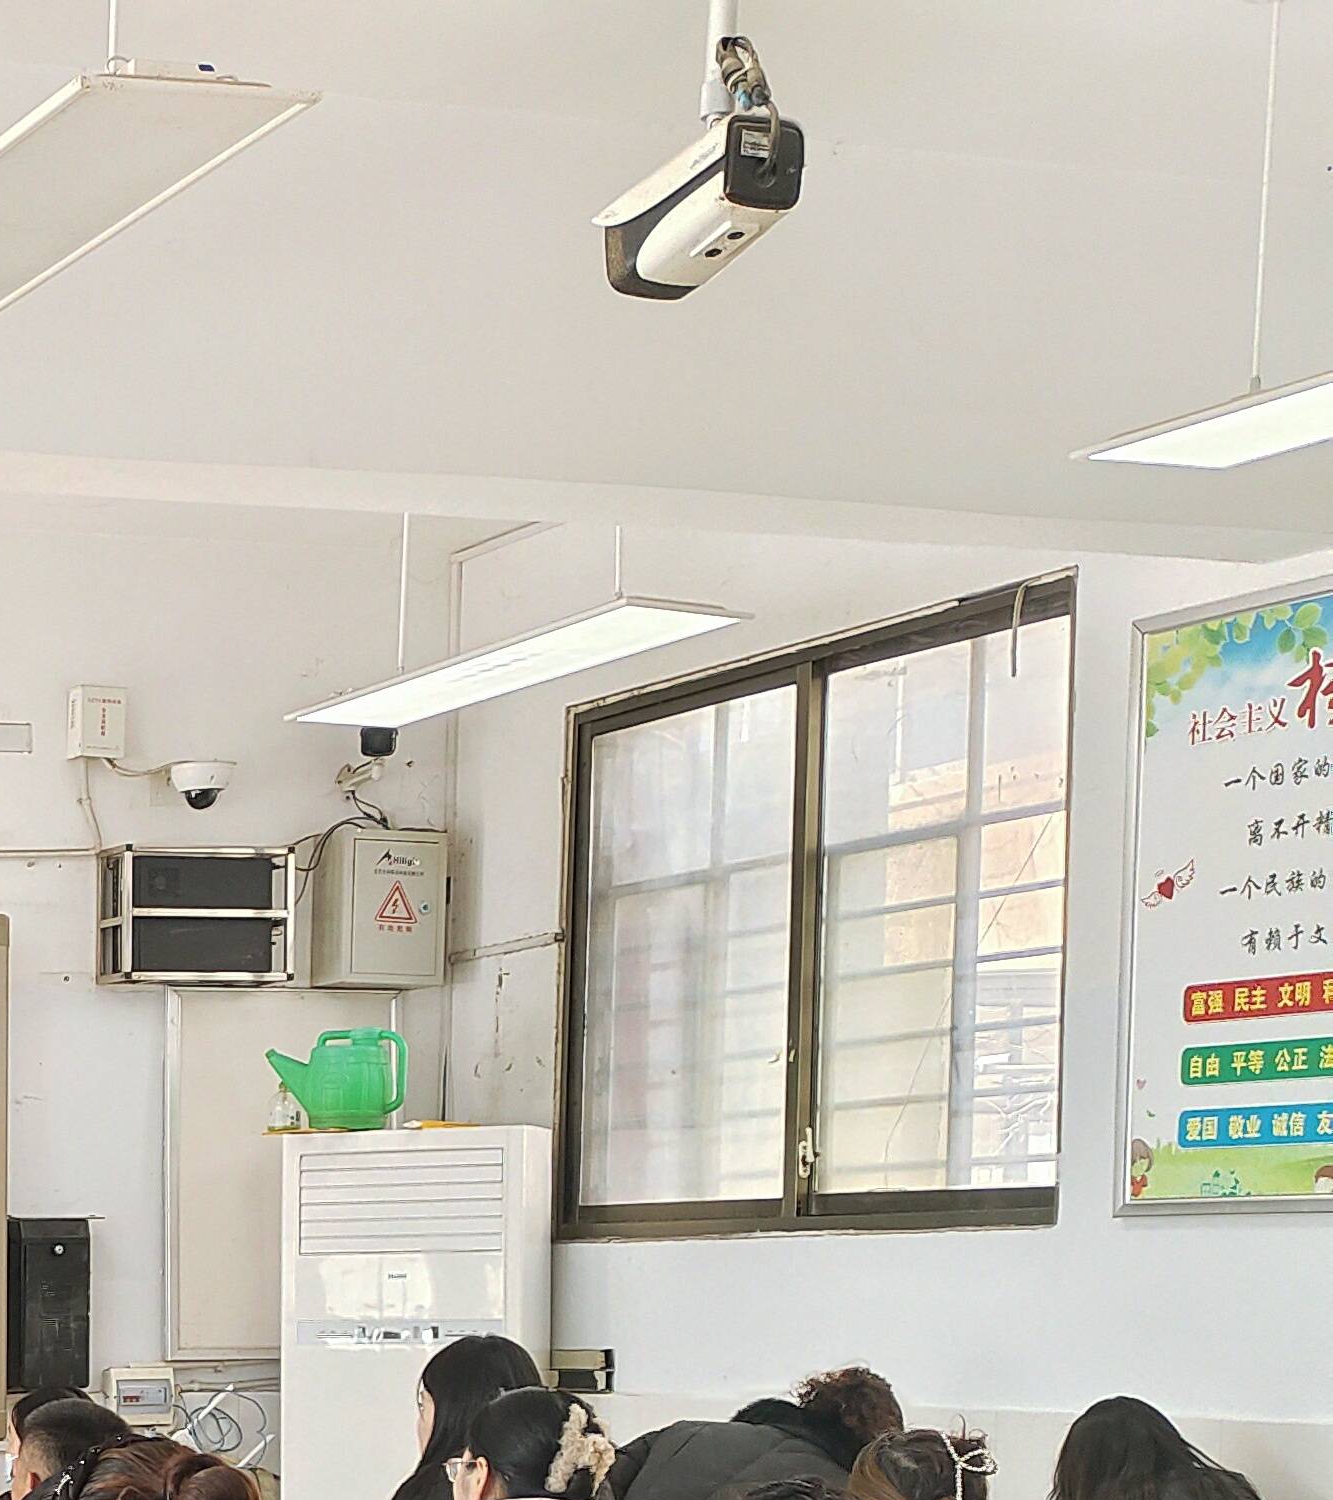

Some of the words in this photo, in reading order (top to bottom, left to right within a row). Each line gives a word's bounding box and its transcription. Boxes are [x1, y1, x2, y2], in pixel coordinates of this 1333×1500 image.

[1189, 698, 1287, 745] 社会主义
[1224, 756, 1330, 791] 一个国家的
[1219, 868, 1327, 901] 一个民族的
[1241, 923, 1329, 954] 有赖于文
[1191, 990, 1224, 1016] 富强
[1234, 986, 1267, 1012] 民主
[1277, 981, 1311, 1008] 文明
[1189, 1053, 1220, 1078] 自由
[1231, 1049, 1265, 1076] 平等
[1275, 1047, 1308, 1072] 公正
[1185, 1116, 1219, 1141] 爱国
[1228, 1113, 1262, 1139] 敬业
[1272, 1111, 1306, 1137] 诚信
[1316, 1110, 1333, 1135] 友
